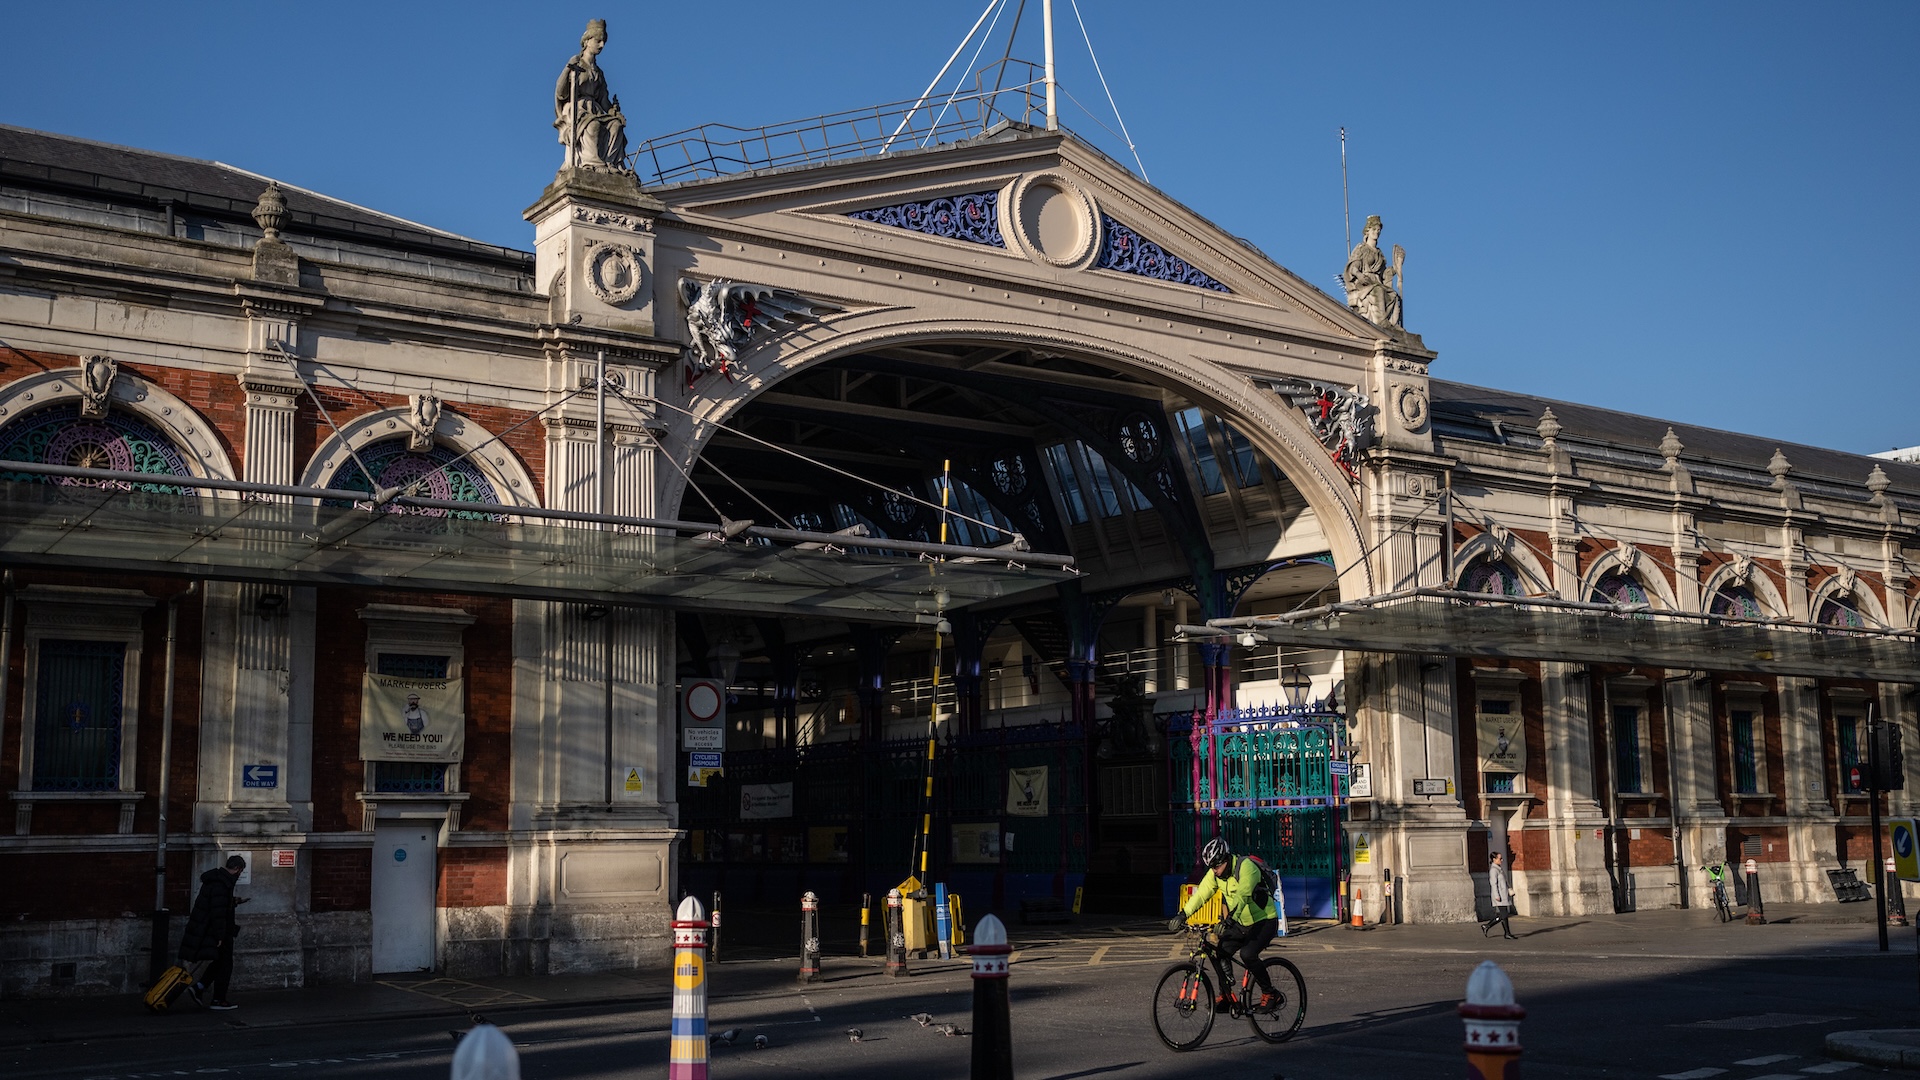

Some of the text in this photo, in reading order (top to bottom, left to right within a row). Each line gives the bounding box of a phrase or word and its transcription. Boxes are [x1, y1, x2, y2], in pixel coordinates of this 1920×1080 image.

[380, 679, 447, 690] MARKET USERS
[382, 732, 443, 743] WE NEED YOU!
